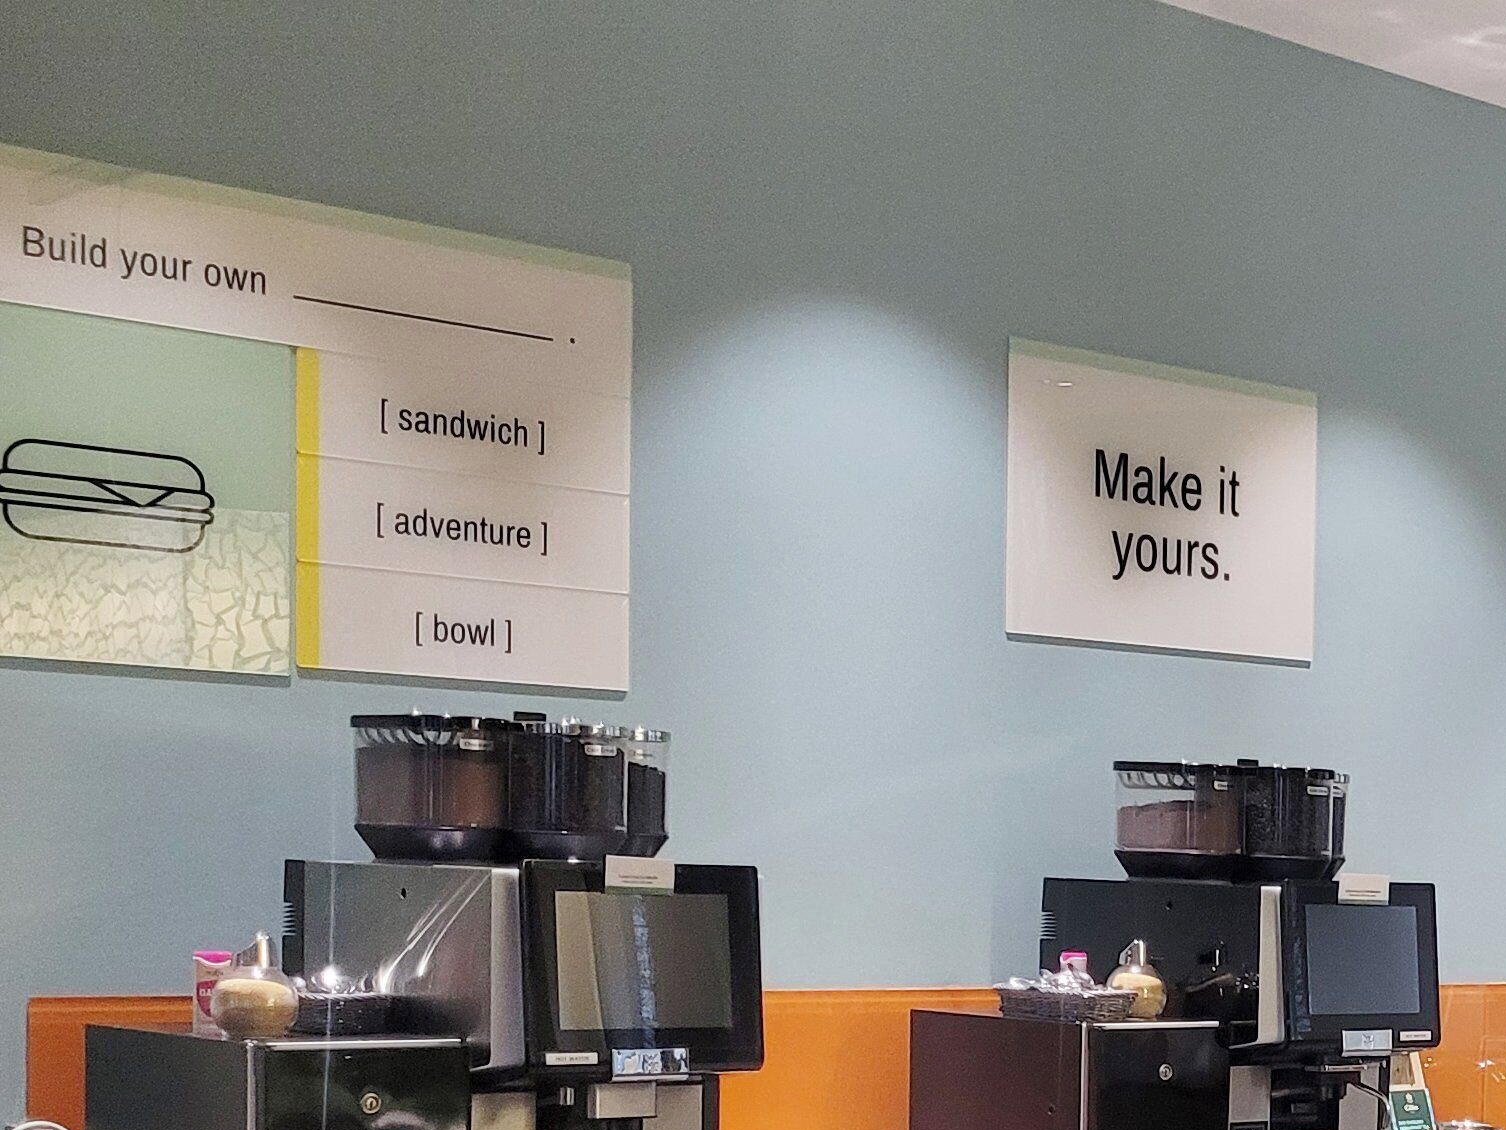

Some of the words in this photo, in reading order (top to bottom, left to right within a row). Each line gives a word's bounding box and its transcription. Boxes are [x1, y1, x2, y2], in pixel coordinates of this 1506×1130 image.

[22, 225, 107, 269] Build
[119, 248, 193, 282] your
[204, 263, 267, 296] own
[1094, 448, 1202, 512] Make
[1219, 464, 1241, 518] it
[1110, 529, 1230, 582] yours.
